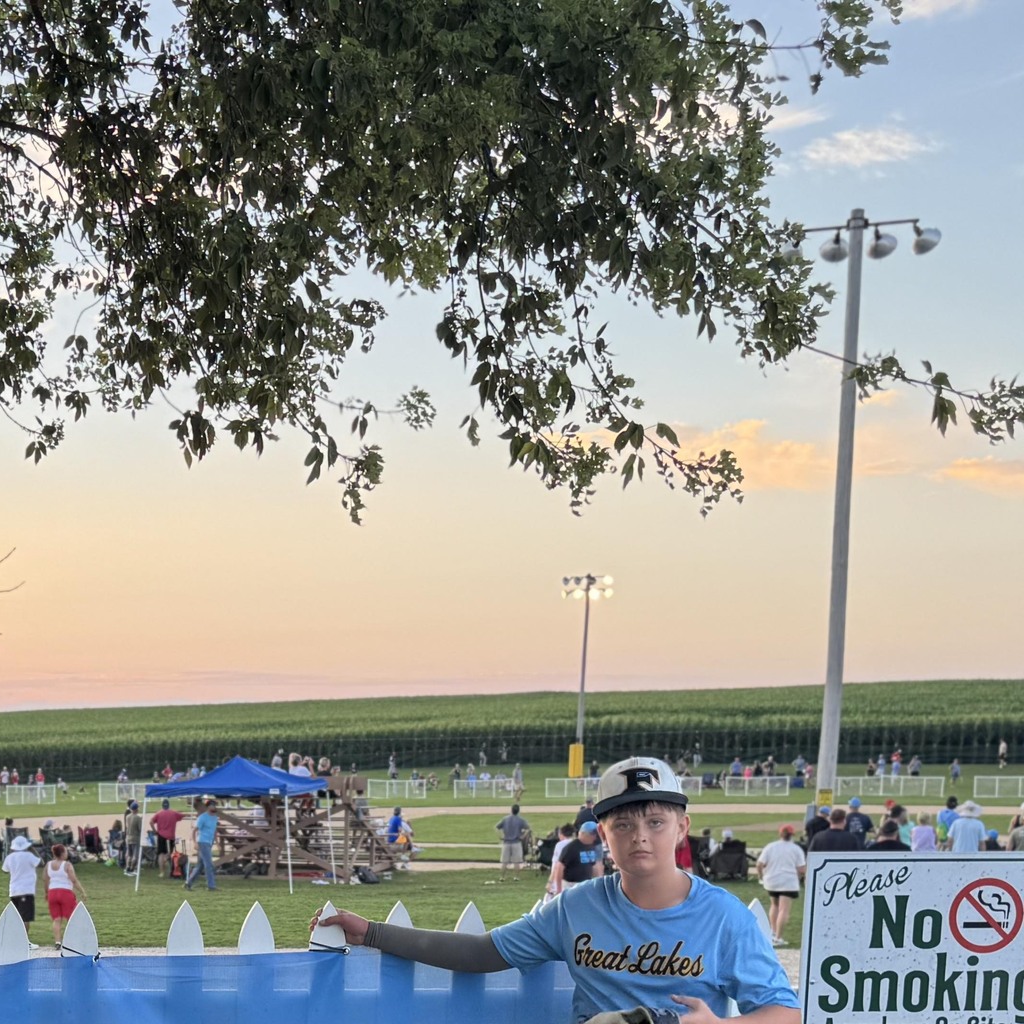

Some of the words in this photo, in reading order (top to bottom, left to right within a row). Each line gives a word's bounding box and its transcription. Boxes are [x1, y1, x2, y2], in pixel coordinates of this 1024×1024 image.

[823, 866, 912, 906] Please
[869, 895, 943, 949] No
[574, 933, 631, 972] Great
[628, 941, 704, 978] Lakes
